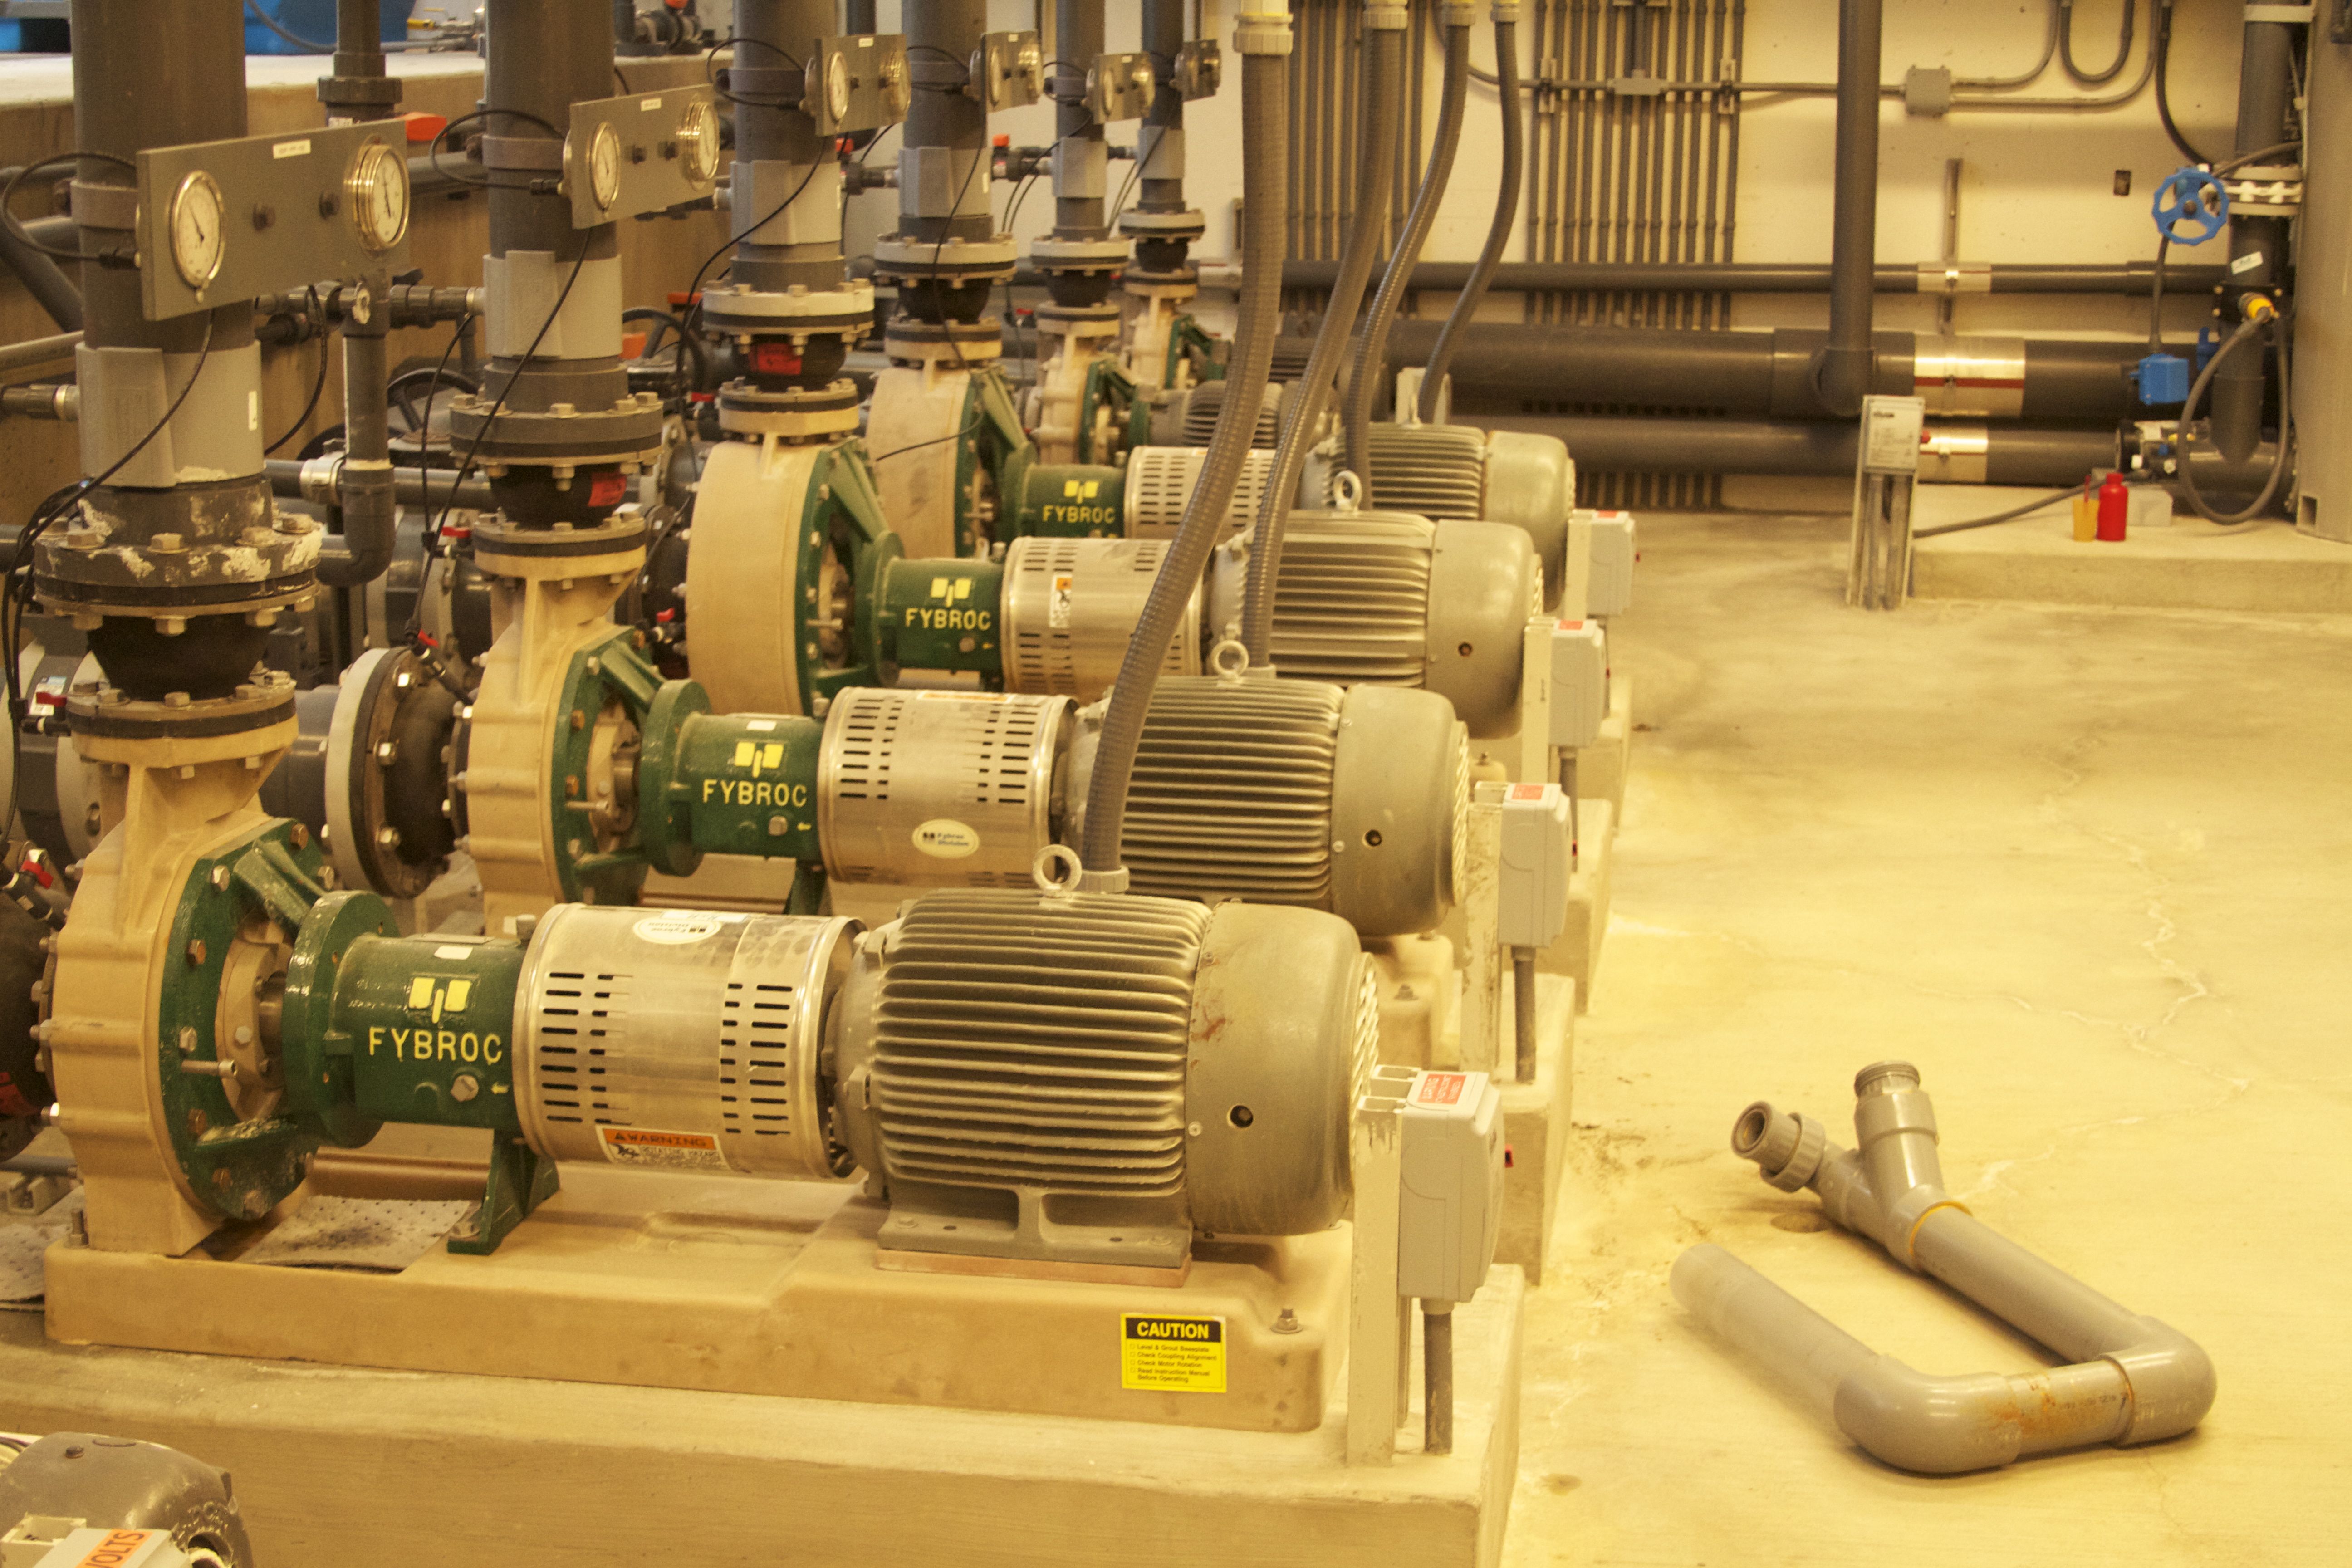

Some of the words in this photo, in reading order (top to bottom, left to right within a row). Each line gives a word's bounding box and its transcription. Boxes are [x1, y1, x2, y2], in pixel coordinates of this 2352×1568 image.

[1043, 505, 1115, 524] FYBROC
[905, 608, 991, 631] FYBROC
[703, 779, 807, 808] FYBROC
[369, 1026, 502, 1065] FYBROC
[628, 1133, 706, 1147] WARNING
[1137, 1321, 1209, 1338] CAUTION
